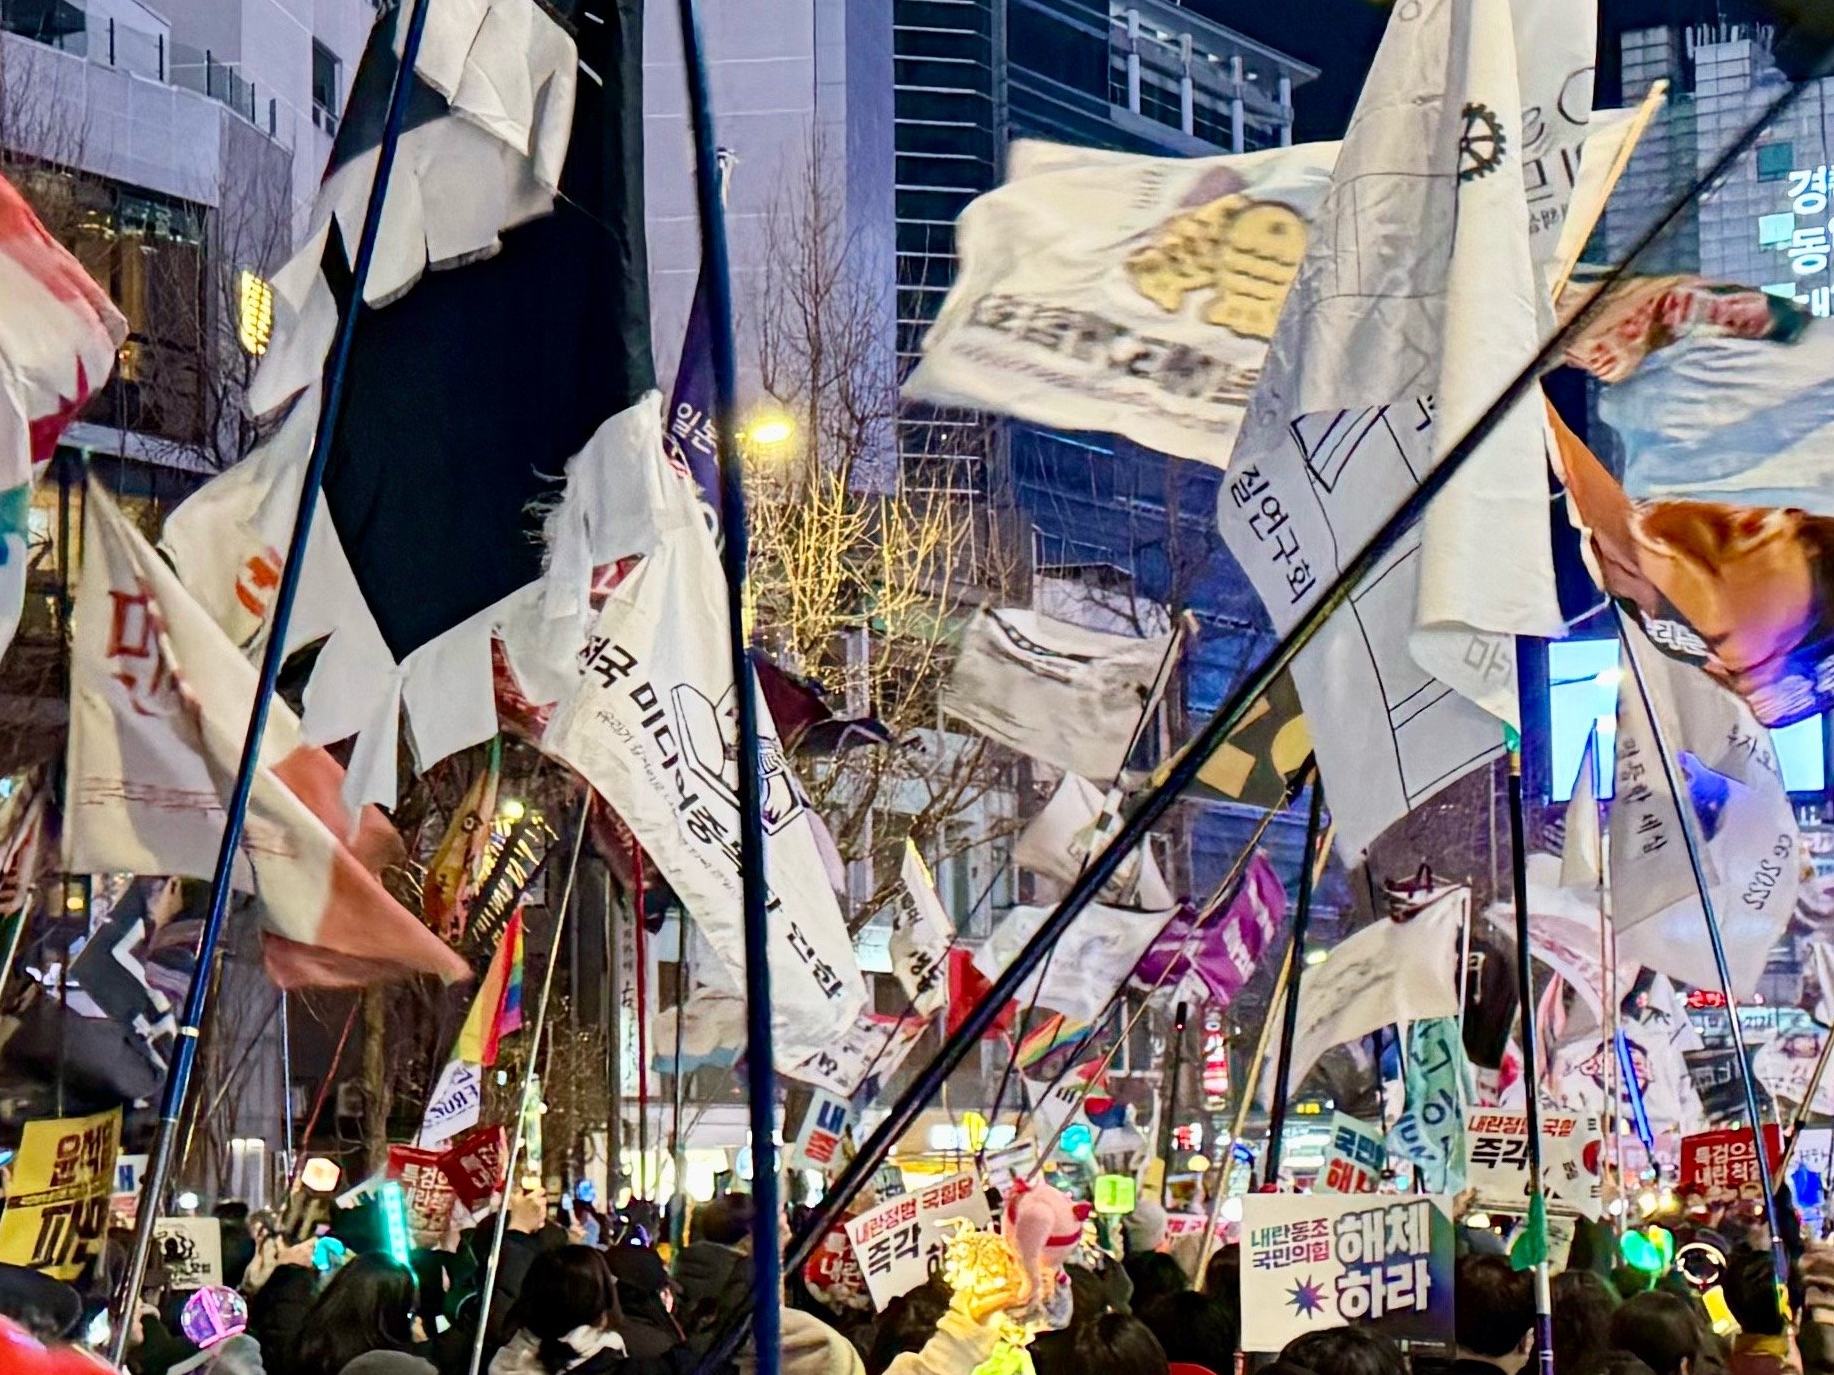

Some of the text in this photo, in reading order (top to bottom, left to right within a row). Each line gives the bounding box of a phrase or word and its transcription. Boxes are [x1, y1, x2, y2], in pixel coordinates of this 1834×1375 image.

[868, 1222, 922, 1277] 즉각
[1250, 1218, 1330, 1249] 내란동조
[1251, 1240, 1330, 1271] 국민의힘
[1334, 1198, 1432, 1265] 해체
[1334, 1258, 1433, 1320] 하라
